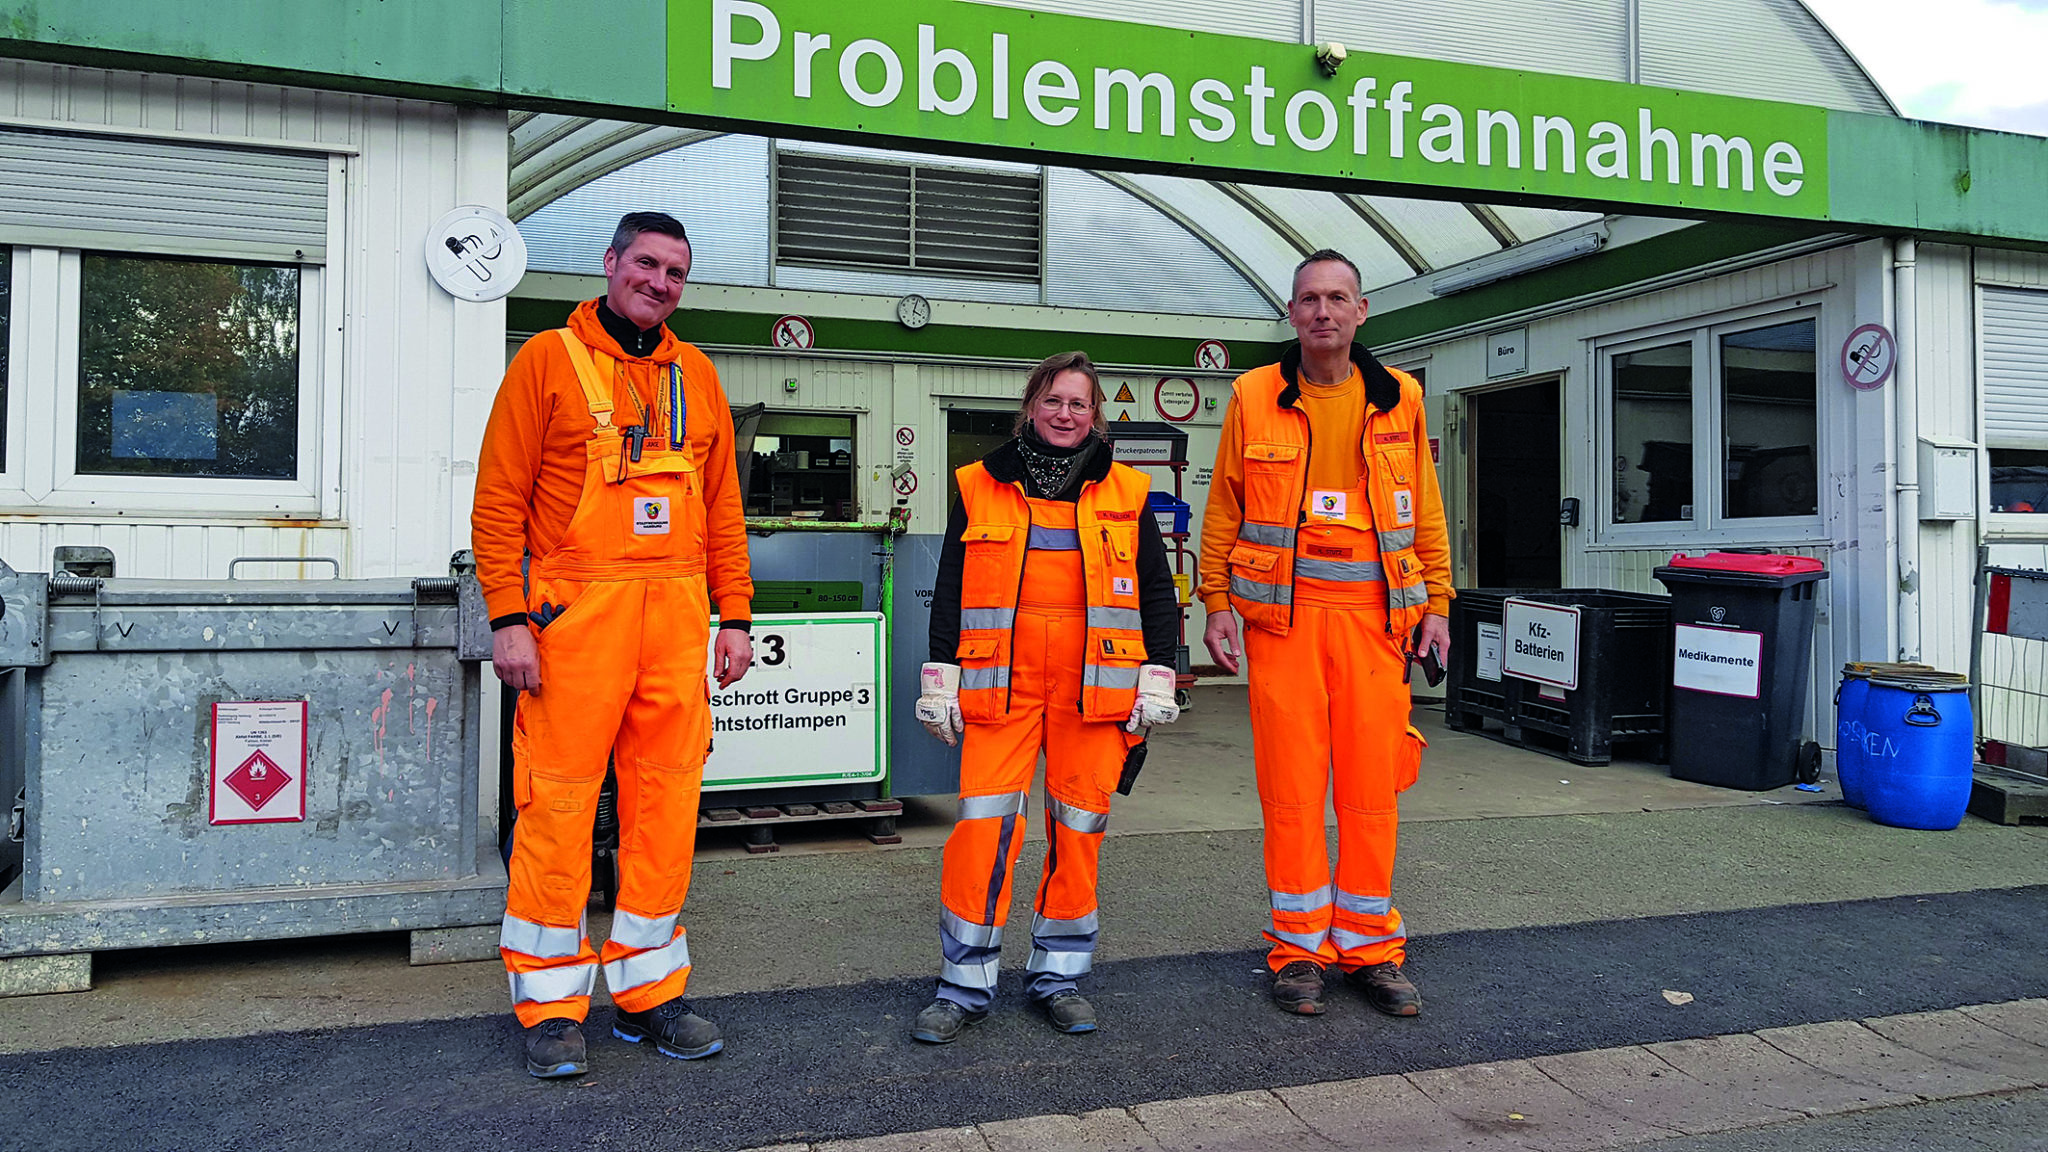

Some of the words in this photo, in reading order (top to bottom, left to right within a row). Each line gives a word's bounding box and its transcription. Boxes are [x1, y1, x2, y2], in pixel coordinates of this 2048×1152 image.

[710, 0, 1804, 197] Problemstoffannahme
[1497, 346, 1515, 356] Büro
[1528, 621, 1551, 639] Kfz-
[1514, 639, 1565, 662] Batterien
[1678, 648, 1754, 667] Medikamente
[784, 688, 853, 706] Gruppe
[857, 688, 870, 705] 3
